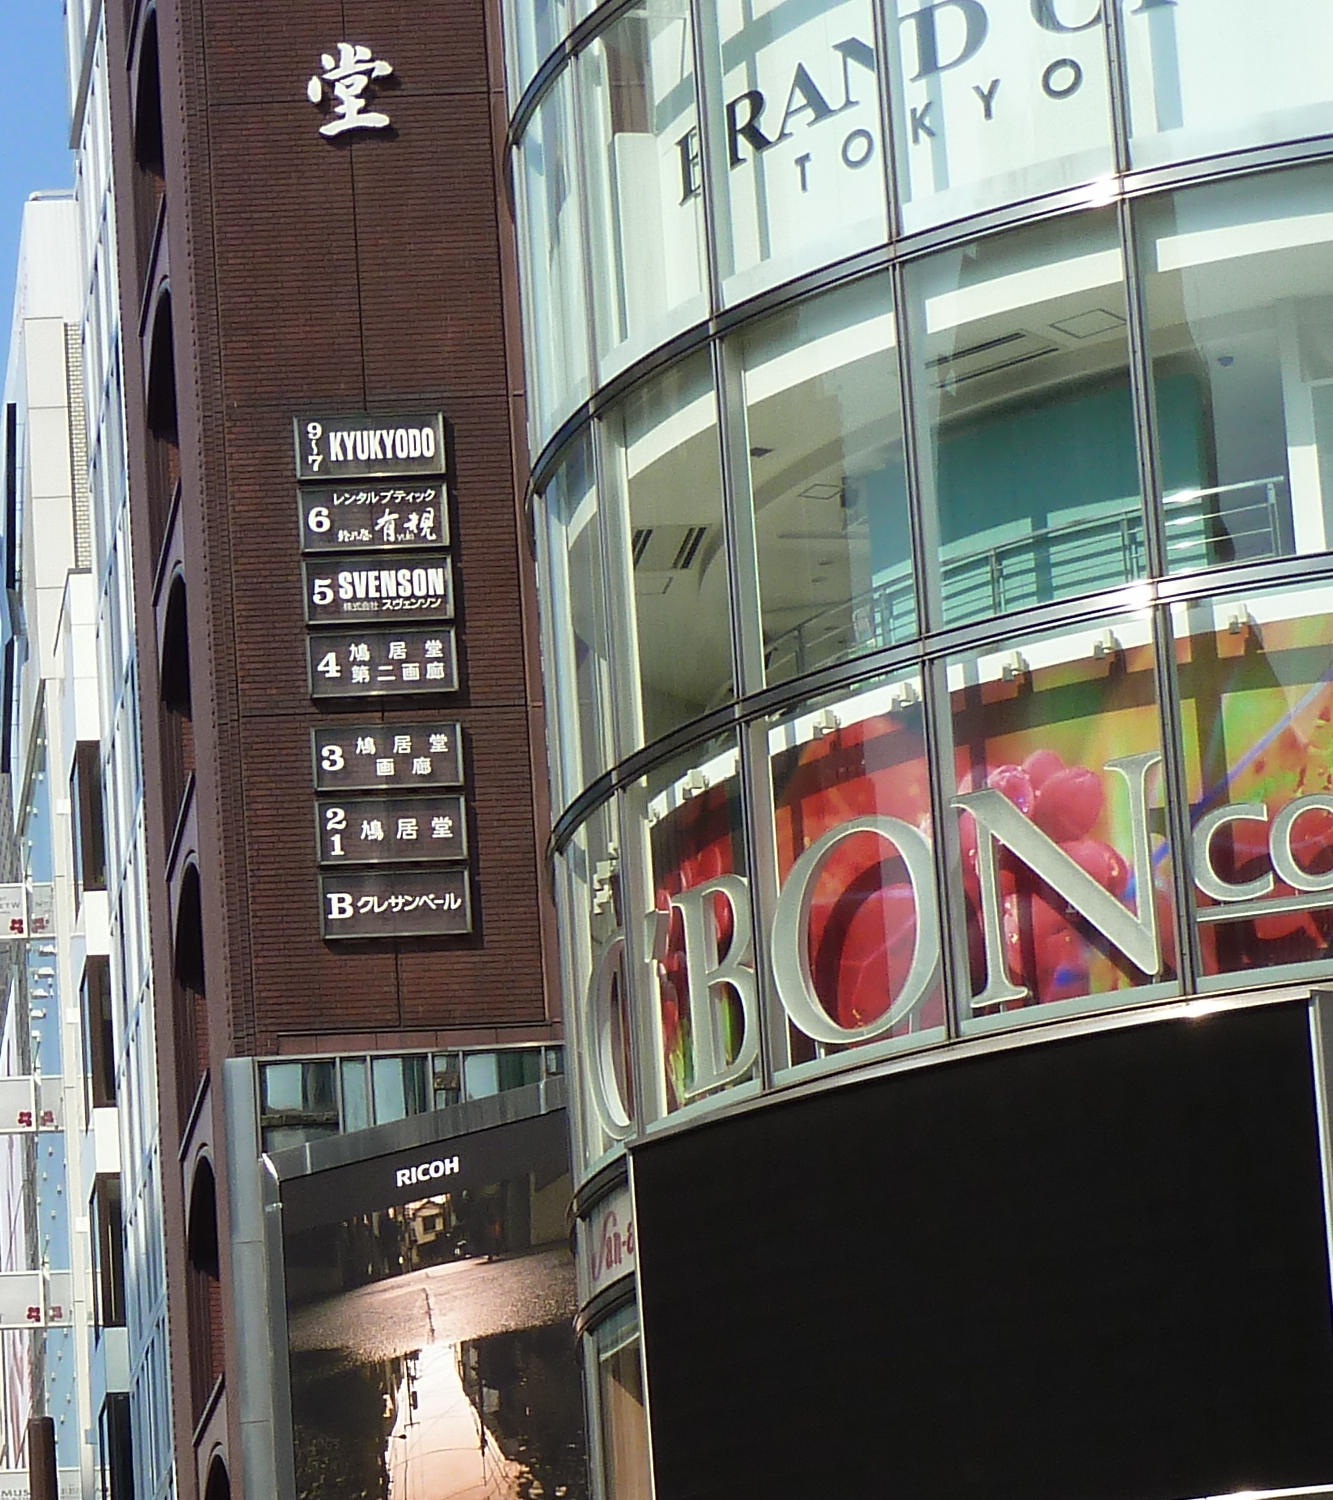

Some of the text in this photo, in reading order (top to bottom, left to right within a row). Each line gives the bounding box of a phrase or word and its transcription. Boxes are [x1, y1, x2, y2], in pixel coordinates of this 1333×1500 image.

[307, 42, 393, 138] 堂
[795, 58, 1083, 191] TOKYO
[329, 427, 435, 461] KYUKYODO
[333, 489, 435, 505] レンタルブティック
[308, 507, 330, 532] 6
[313, 568, 444, 605] 5 SVENSON
[343, 597, 441, 612] 株式会社 スヴェンソン
[317, 639, 444, 678] 4 鳩居堂
[351, 662, 445, 683] 第二画廊
[321, 733, 448, 771] 3 鳩居堂
[376, 757, 431, 776] 画廊
[325, 807, 347, 831] 2
[330, 816, 454, 856] 1 鳩居堂
[327, 892, 462, 919] B クレサンベール
[396, 1155, 461, 1187] RICOH
